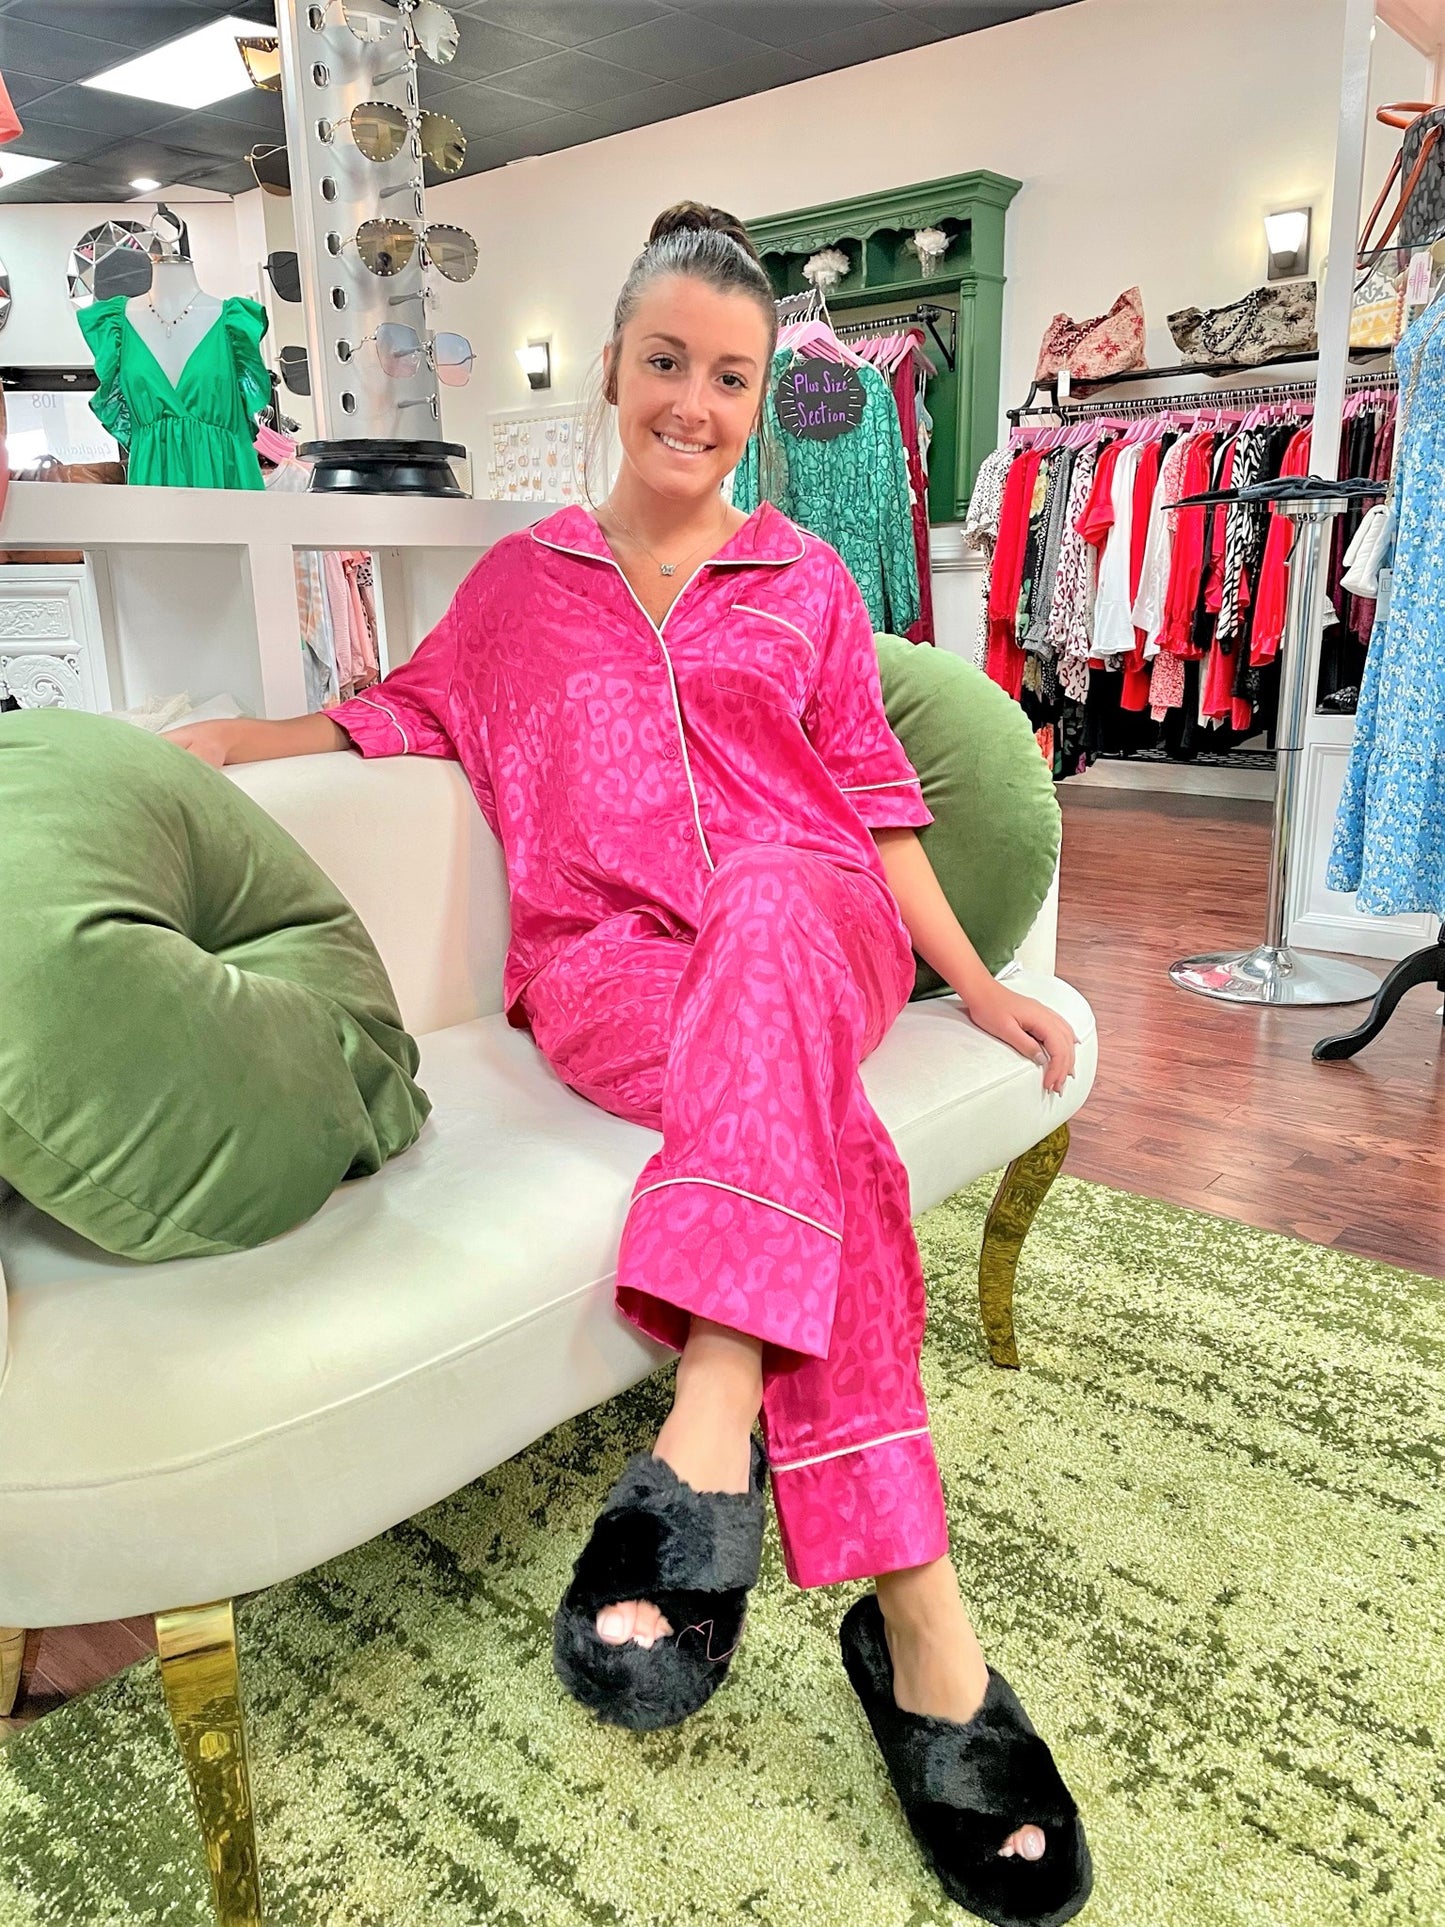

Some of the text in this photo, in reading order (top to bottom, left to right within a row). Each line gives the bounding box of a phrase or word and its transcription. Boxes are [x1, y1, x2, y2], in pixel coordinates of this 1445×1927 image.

[794, 370, 848, 394] Plus Size
[797, 401, 846, 428] Section
